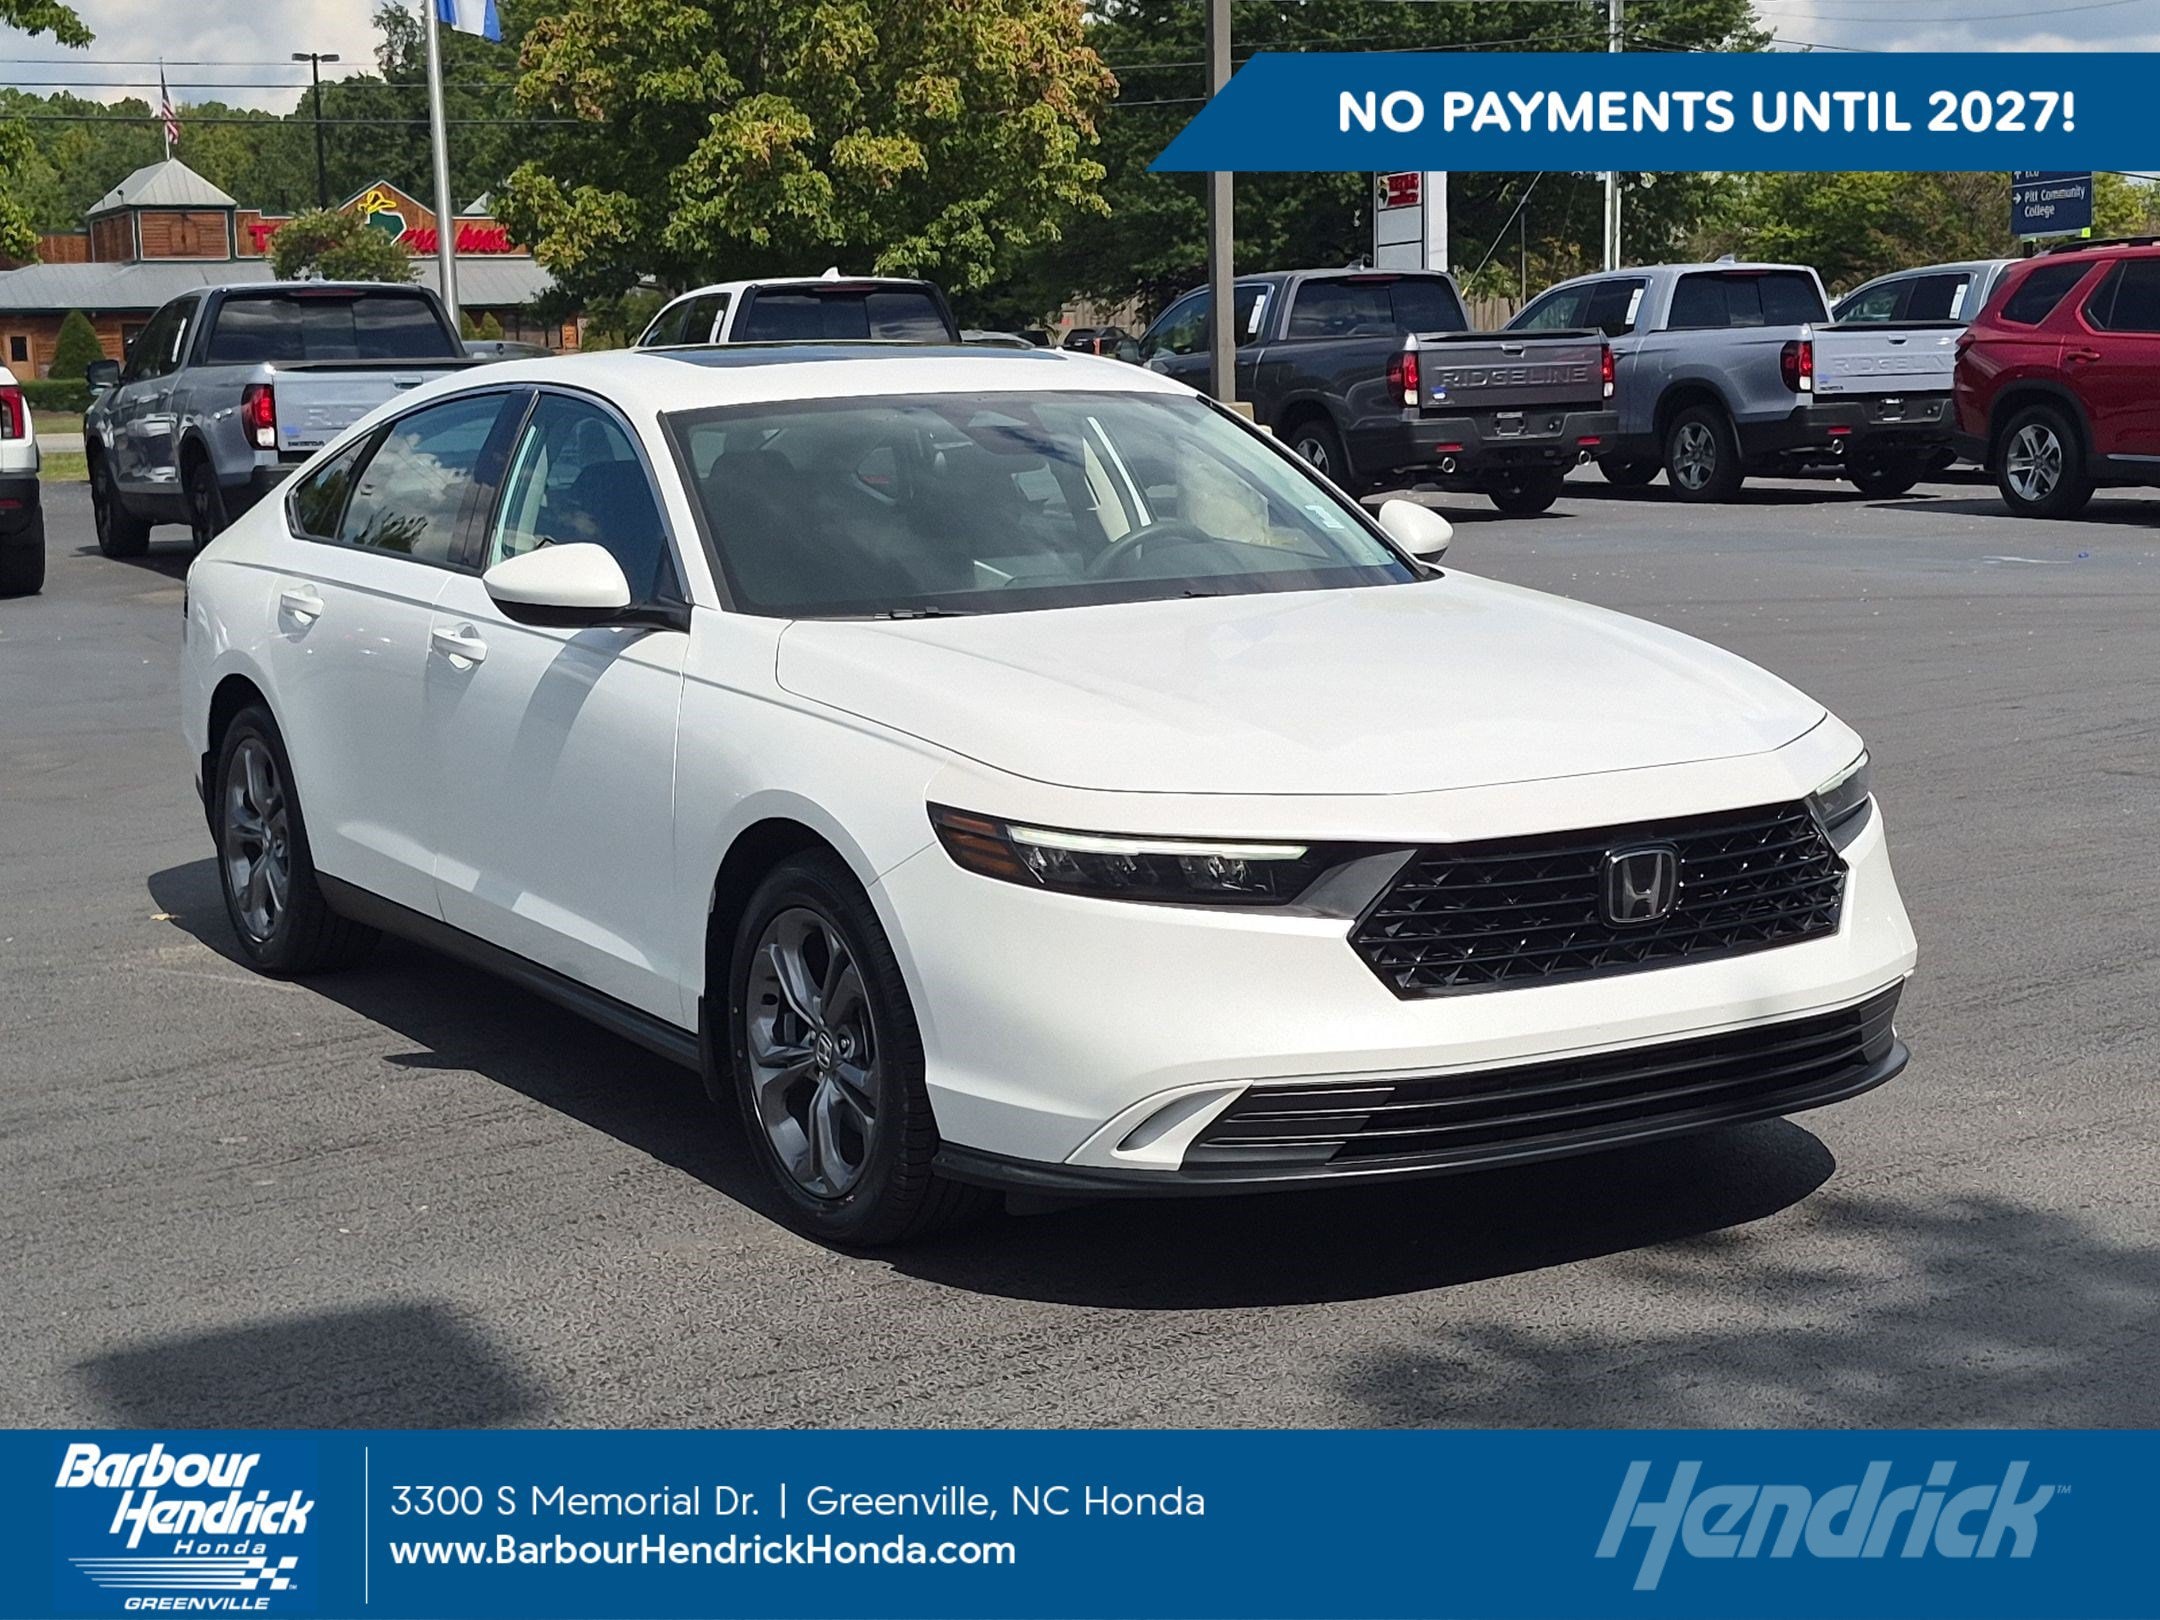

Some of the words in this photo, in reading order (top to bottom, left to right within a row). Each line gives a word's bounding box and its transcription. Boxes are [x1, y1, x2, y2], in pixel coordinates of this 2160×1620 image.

[2024, 190, 2039, 203] Pitt
[2024, 204, 2056, 218] College
[1441, 367, 1589, 387] RIDGELINE
